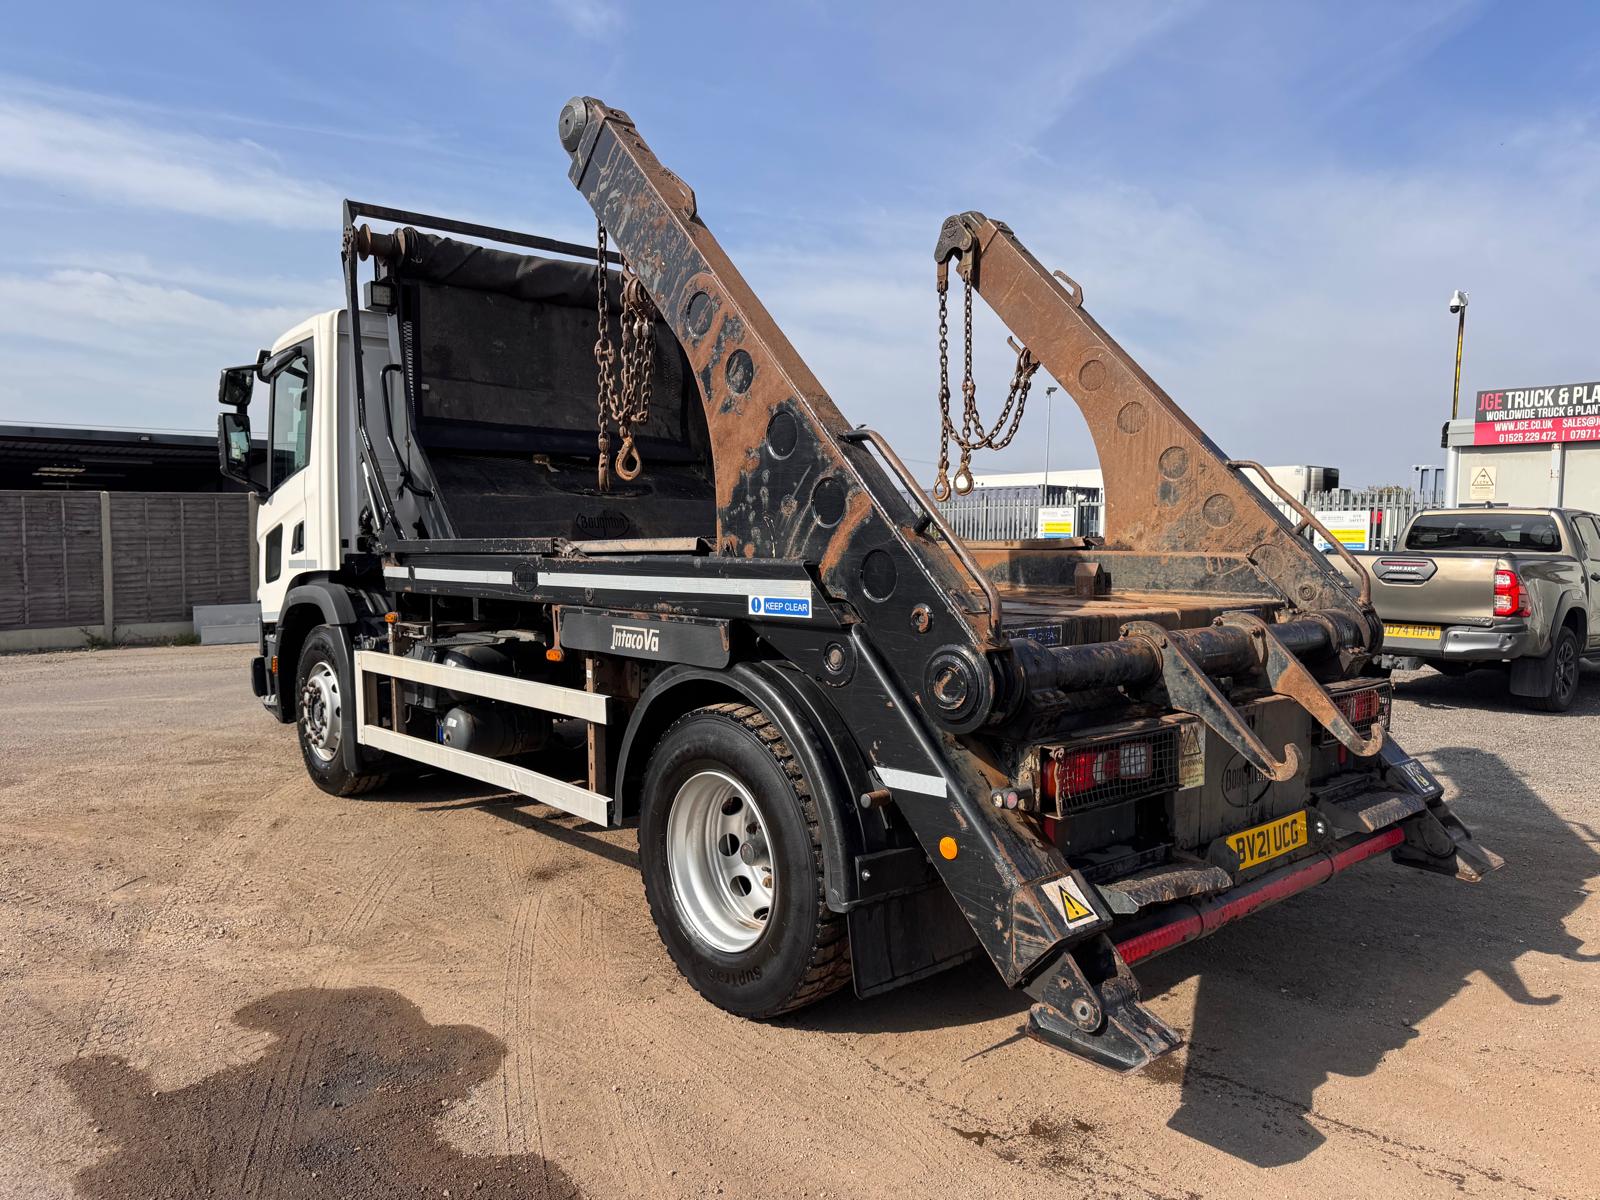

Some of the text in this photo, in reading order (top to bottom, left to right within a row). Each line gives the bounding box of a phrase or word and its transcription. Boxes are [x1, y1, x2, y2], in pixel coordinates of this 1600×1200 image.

[1506, 388, 1555, 409] TRUCK
[1558, 387, 1570, 405] &
[1486, 408, 1536, 421] WORLDWIDE
[1537, 406, 1565, 418] TRUCK
[1567, 406, 1574, 416] &
[1499, 429, 1596, 442] 01525 229 472 07971
[765, 598, 808, 612] KEEP CLEAR
[1413, 624, 1436, 637] HPN
[1236, 819, 1299, 864] BV21 UCG
